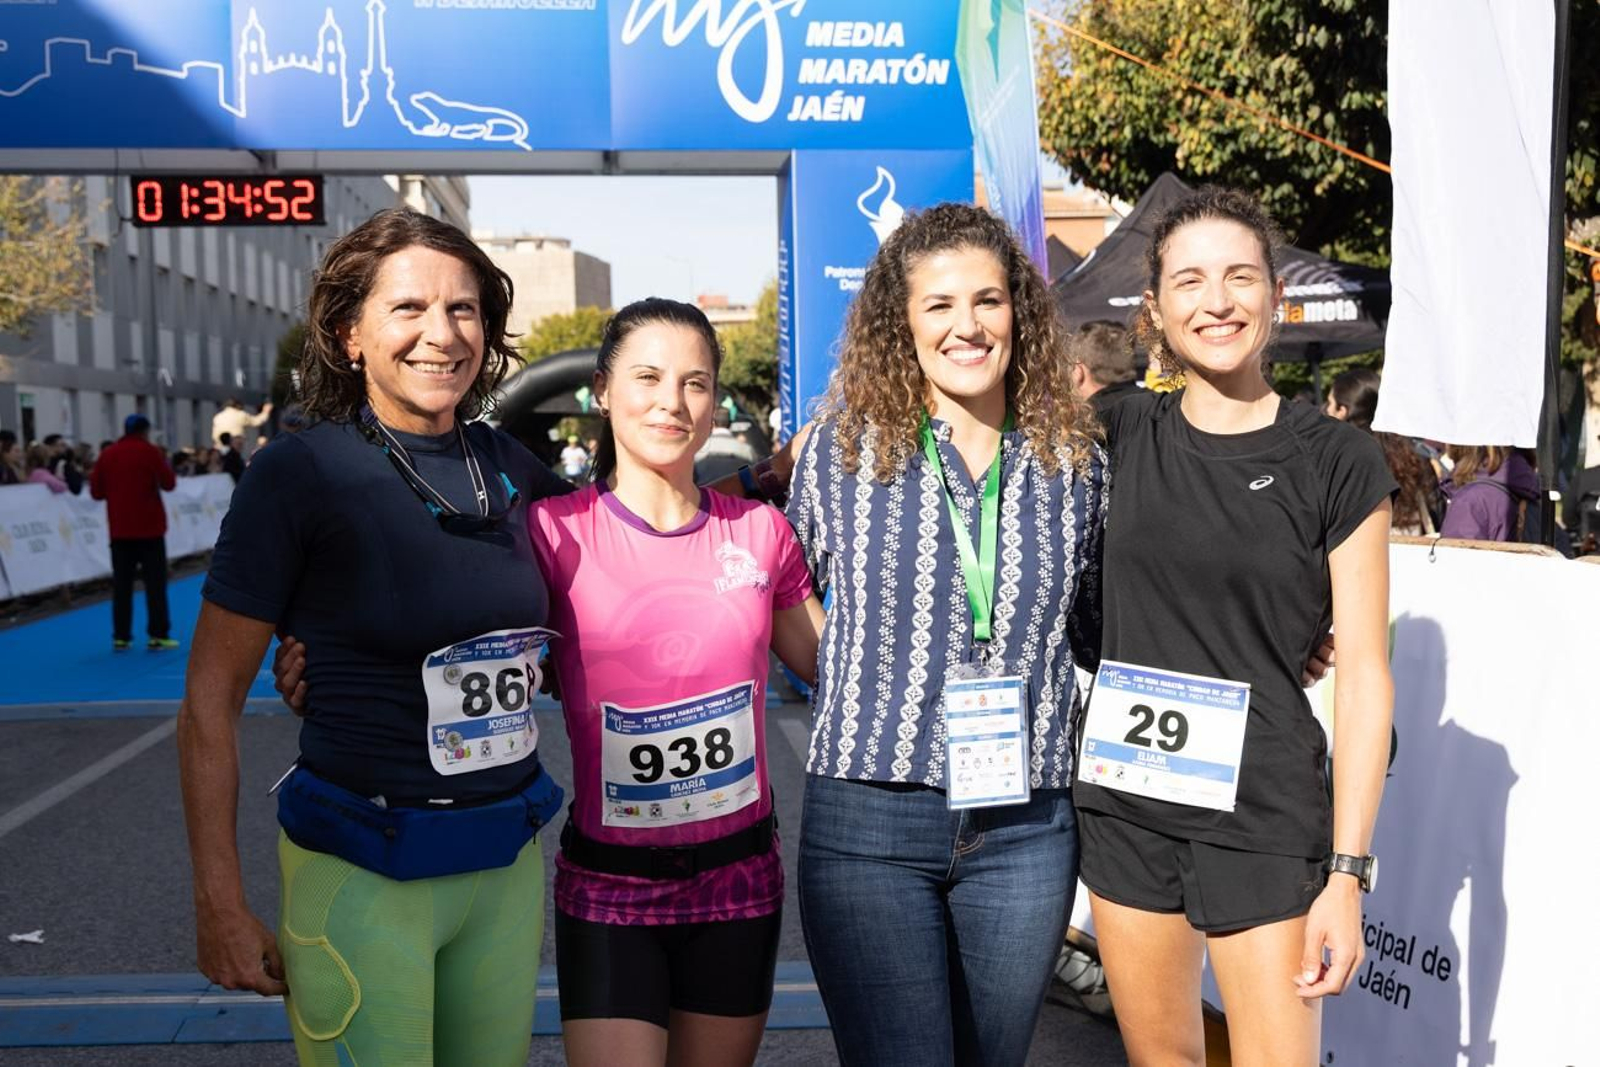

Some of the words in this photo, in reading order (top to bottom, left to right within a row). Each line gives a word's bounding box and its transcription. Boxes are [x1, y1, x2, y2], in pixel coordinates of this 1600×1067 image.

[805, 21, 904, 48] MEDIA
[799, 53, 950, 85] MARATÓN
[787, 90, 865, 122] JAÉN
[1123, 703, 1189, 753] 29
[629, 727, 734, 783] 938
[670, 778, 707, 793] MARÍA
[1421, 945, 1451, 982] de
[1358, 961, 1411, 1010] Jaén
